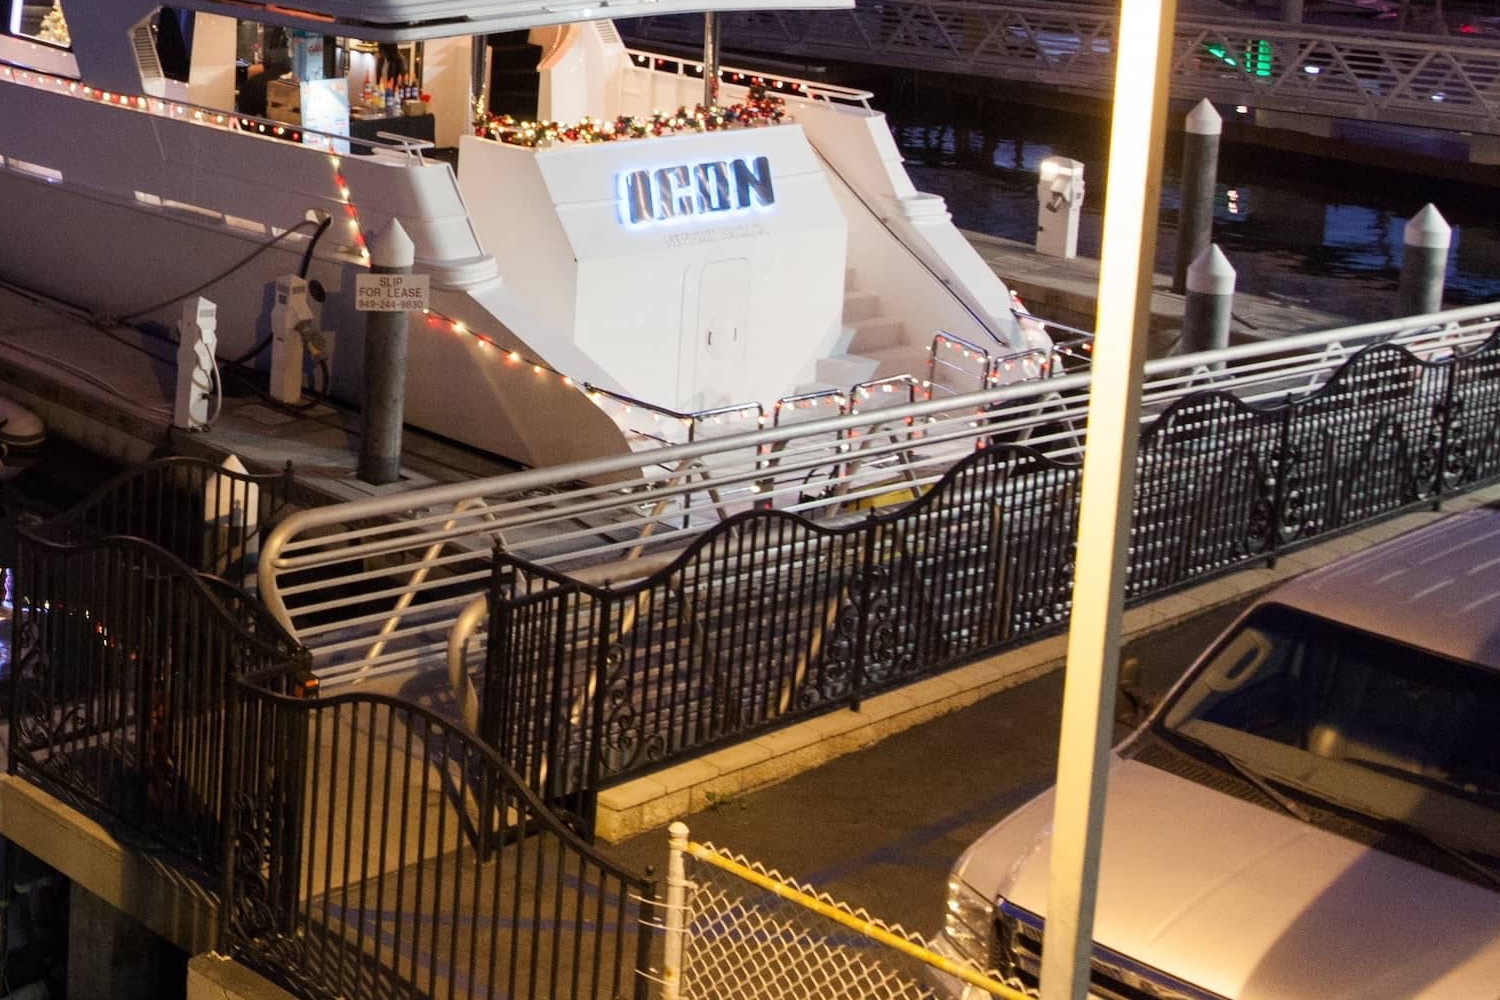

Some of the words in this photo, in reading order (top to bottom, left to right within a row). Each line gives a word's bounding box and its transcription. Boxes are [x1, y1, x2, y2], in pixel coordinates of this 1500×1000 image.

[626, 156, 775, 224] ICON
[379, 276, 403, 288] SLIP
[359, 287, 381, 297] FOR
[387, 287, 422, 298] LEASE
